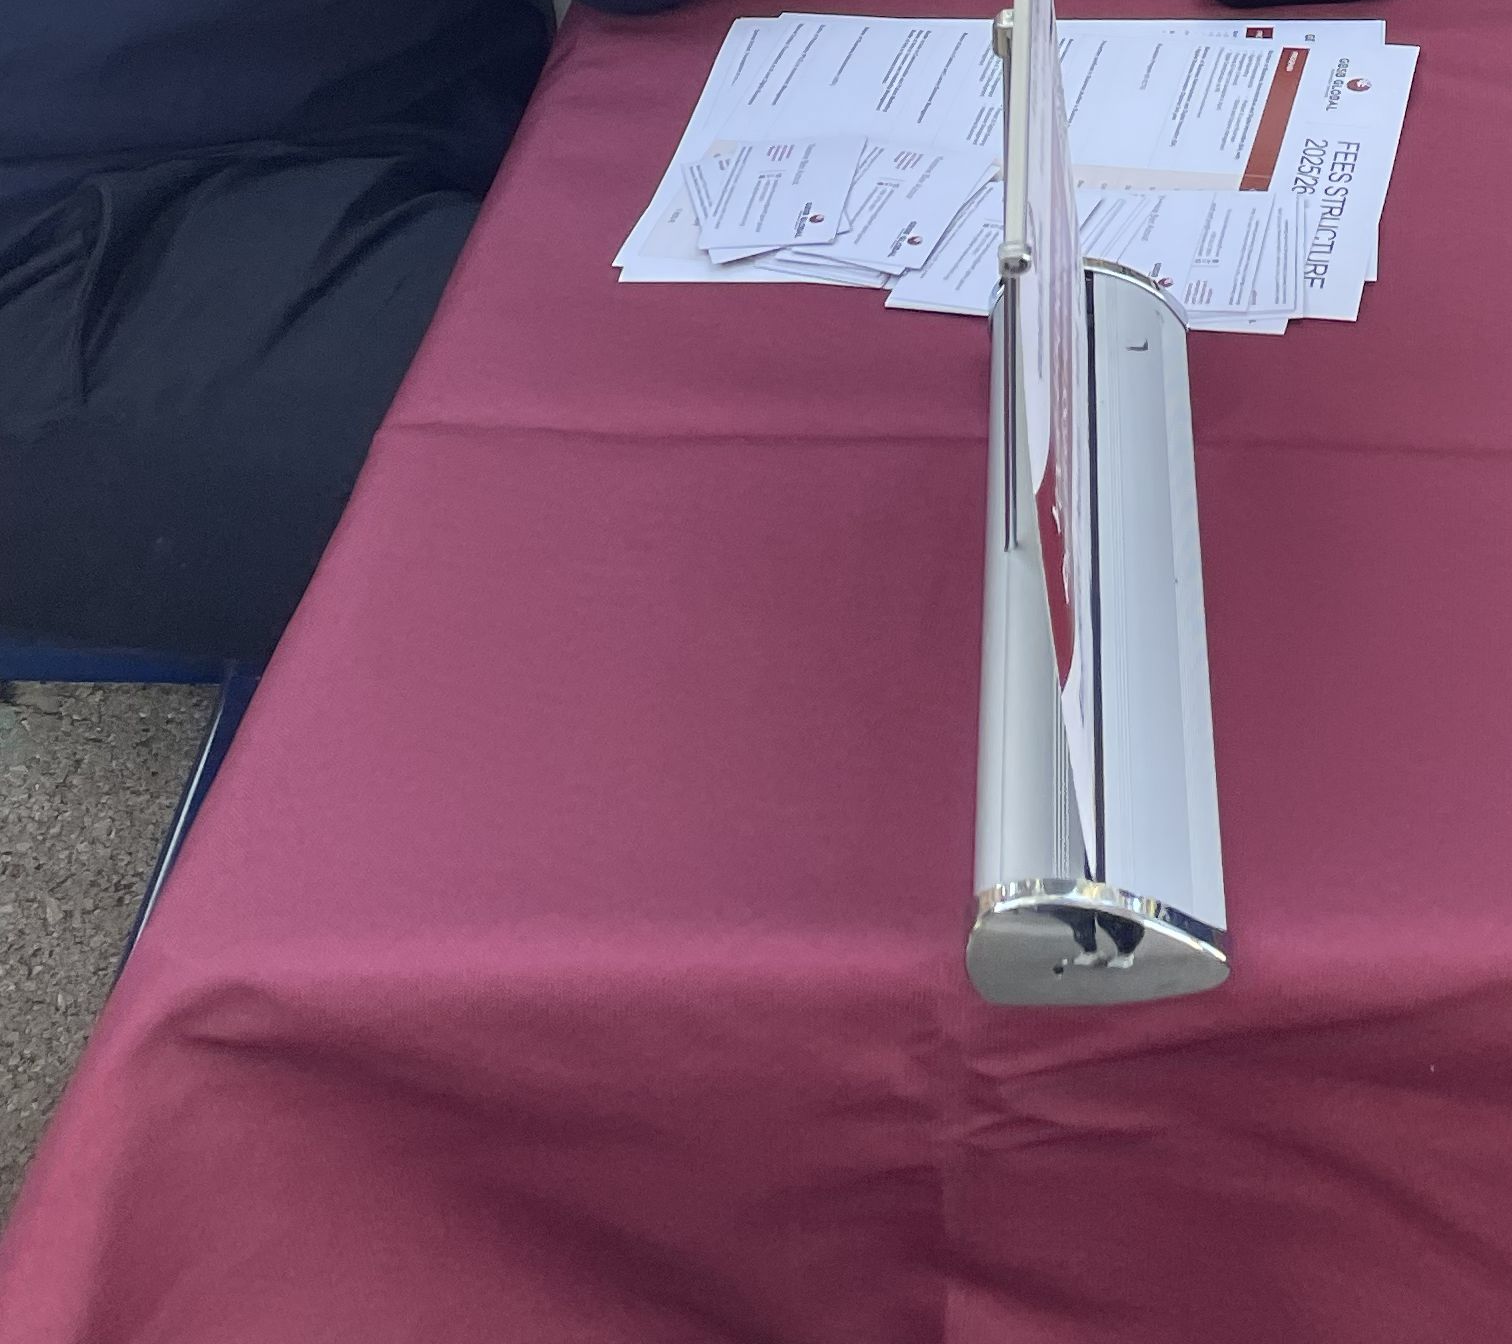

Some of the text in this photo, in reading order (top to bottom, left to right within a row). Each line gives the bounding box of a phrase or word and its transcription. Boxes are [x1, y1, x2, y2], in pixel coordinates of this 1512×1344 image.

[1325, 79, 1345, 112] GLOBAL
[1291, 138, 1329, 197] 2025/26
[1303, 141, 1360, 289] FEES STRUCTURE
